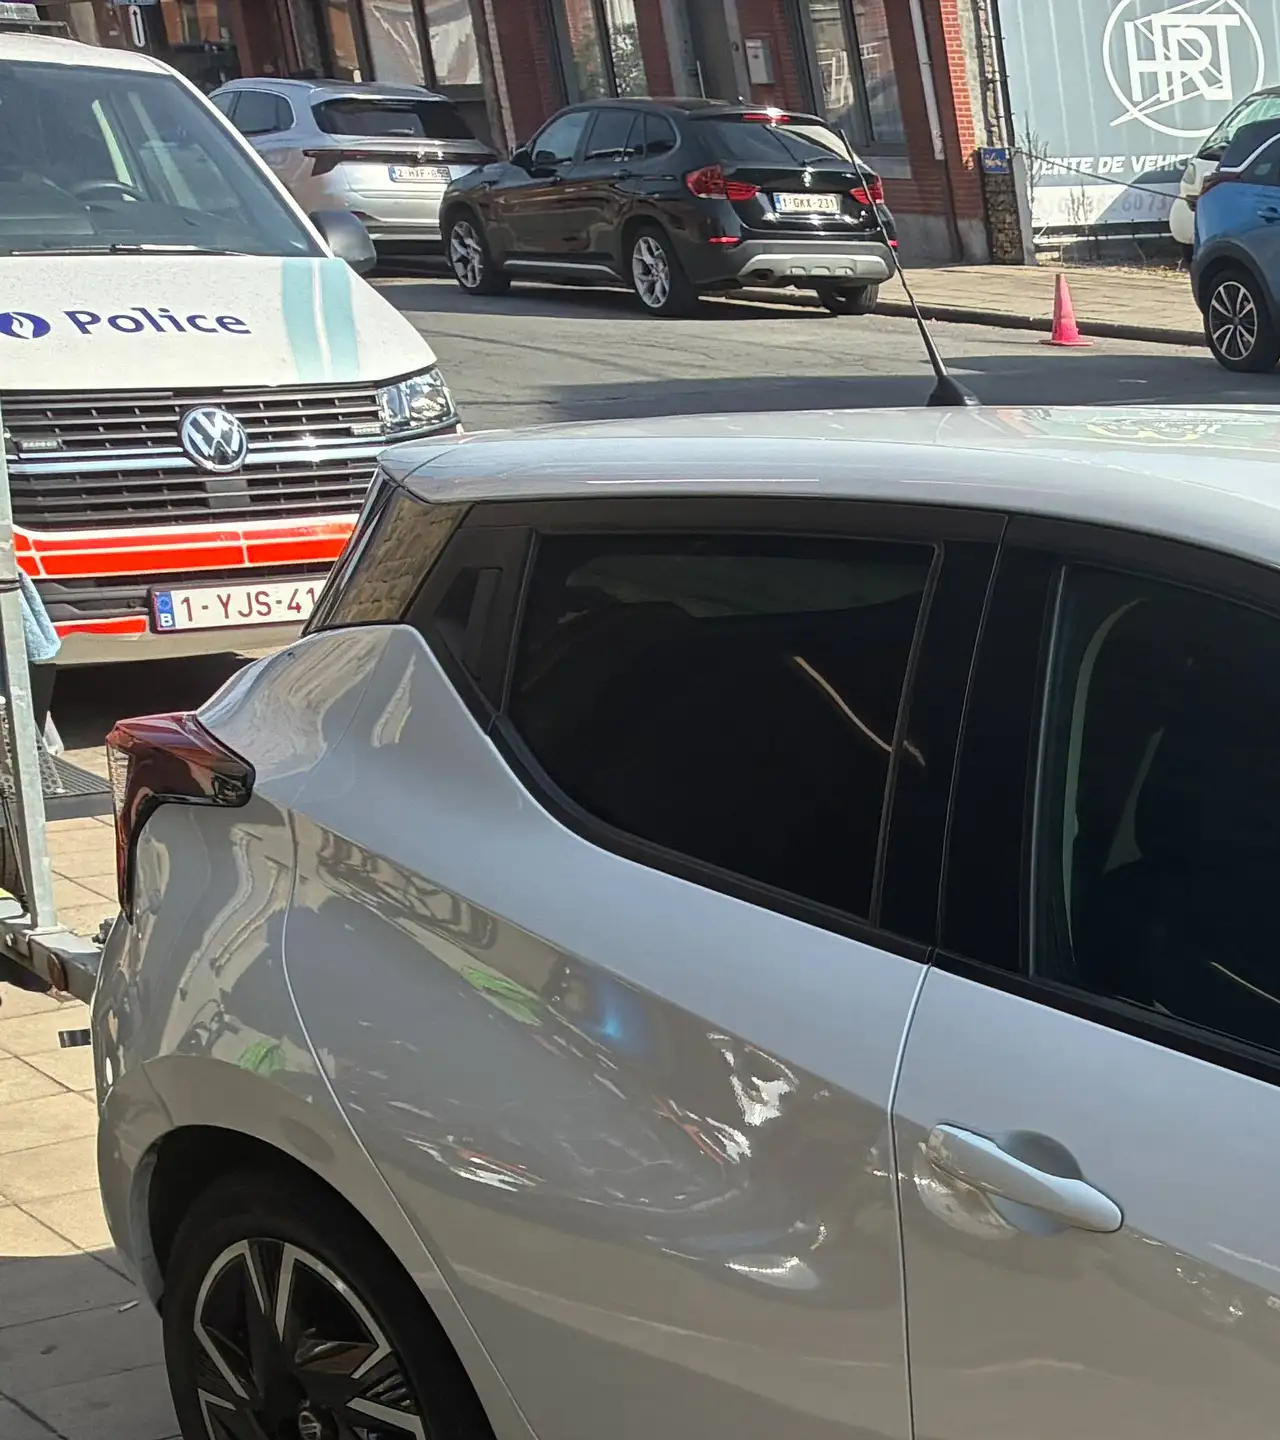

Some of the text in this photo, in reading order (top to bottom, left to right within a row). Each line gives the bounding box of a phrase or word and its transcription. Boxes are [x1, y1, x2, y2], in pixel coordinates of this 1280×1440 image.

[1097, 155, 1126, 174] DE
[63, 307, 252, 335] Police
[160, 613, 173, 627] B
